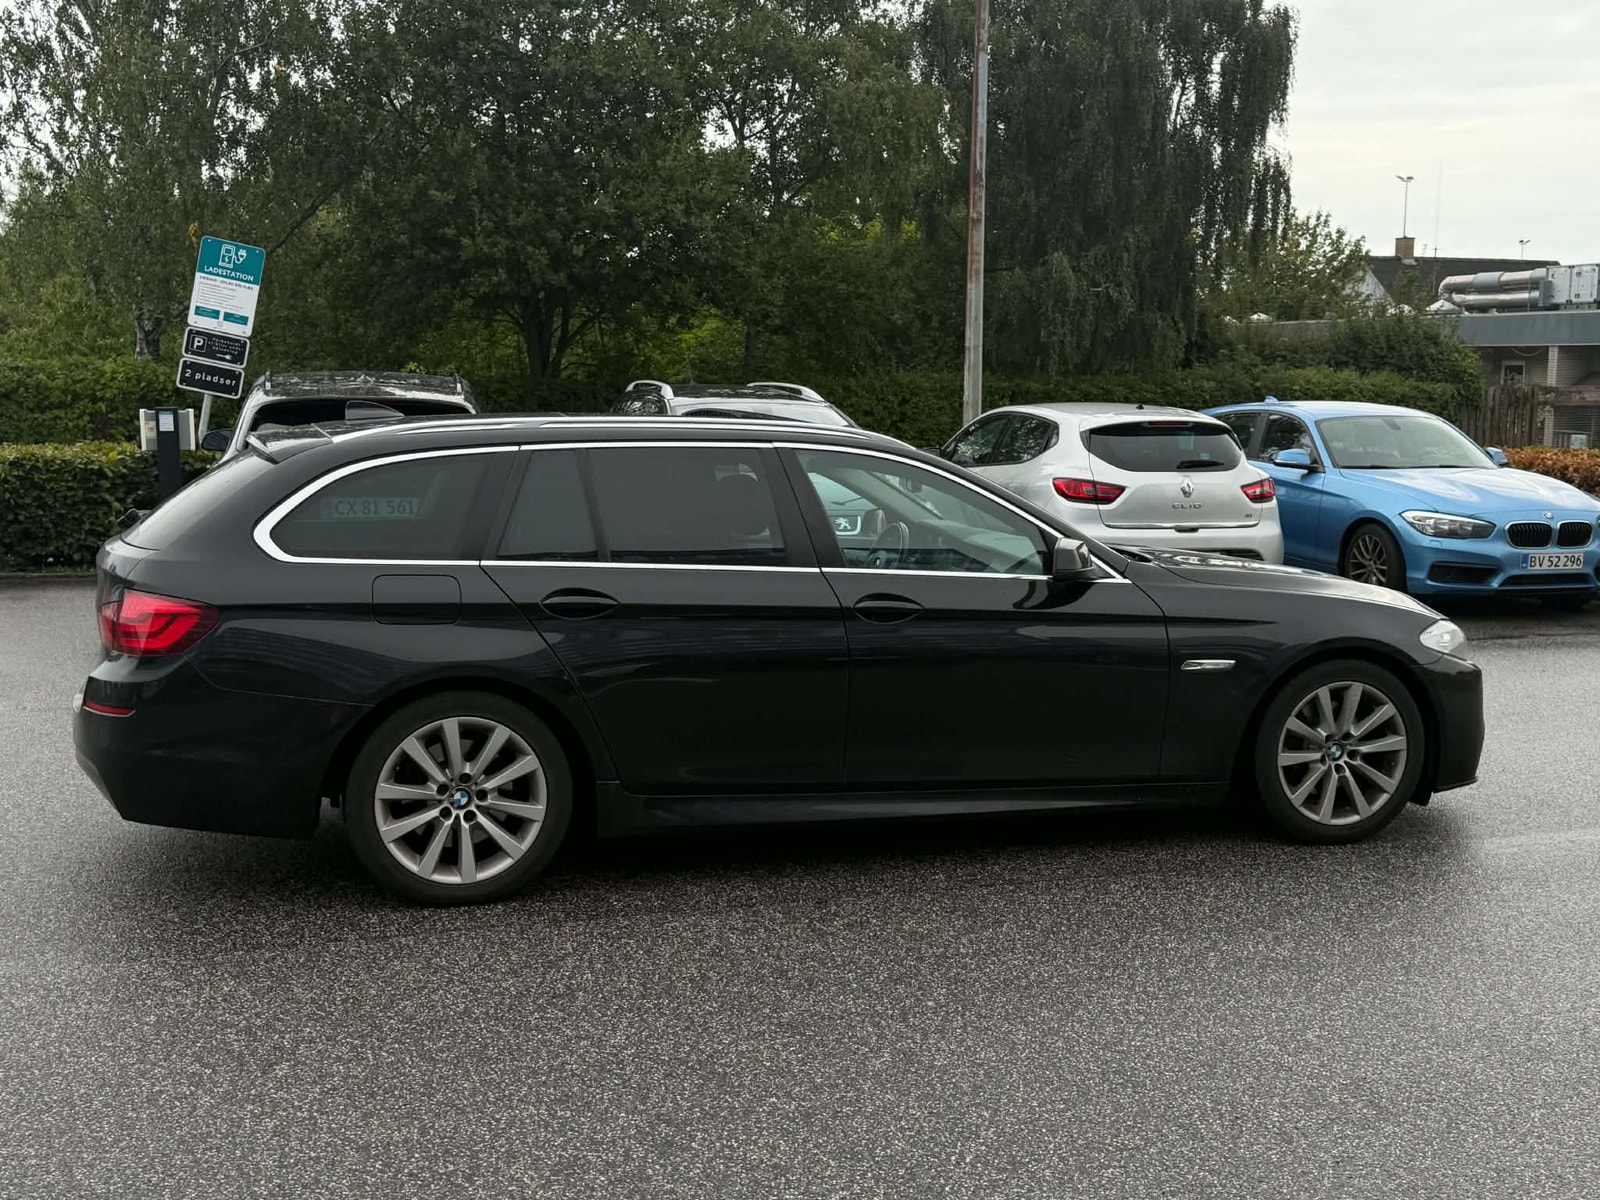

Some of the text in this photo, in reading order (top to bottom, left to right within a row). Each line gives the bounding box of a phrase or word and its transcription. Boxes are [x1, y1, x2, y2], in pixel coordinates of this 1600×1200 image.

[204, 265, 254, 282] LADESTATION
[193, 337, 204, 349] P
[184, 369, 237, 387] 2 pladser
[335, 499, 414, 516] CX 81 561
[1171, 502, 1202, 510] CLIO
[1529, 554, 1582, 568] BV 52 296
